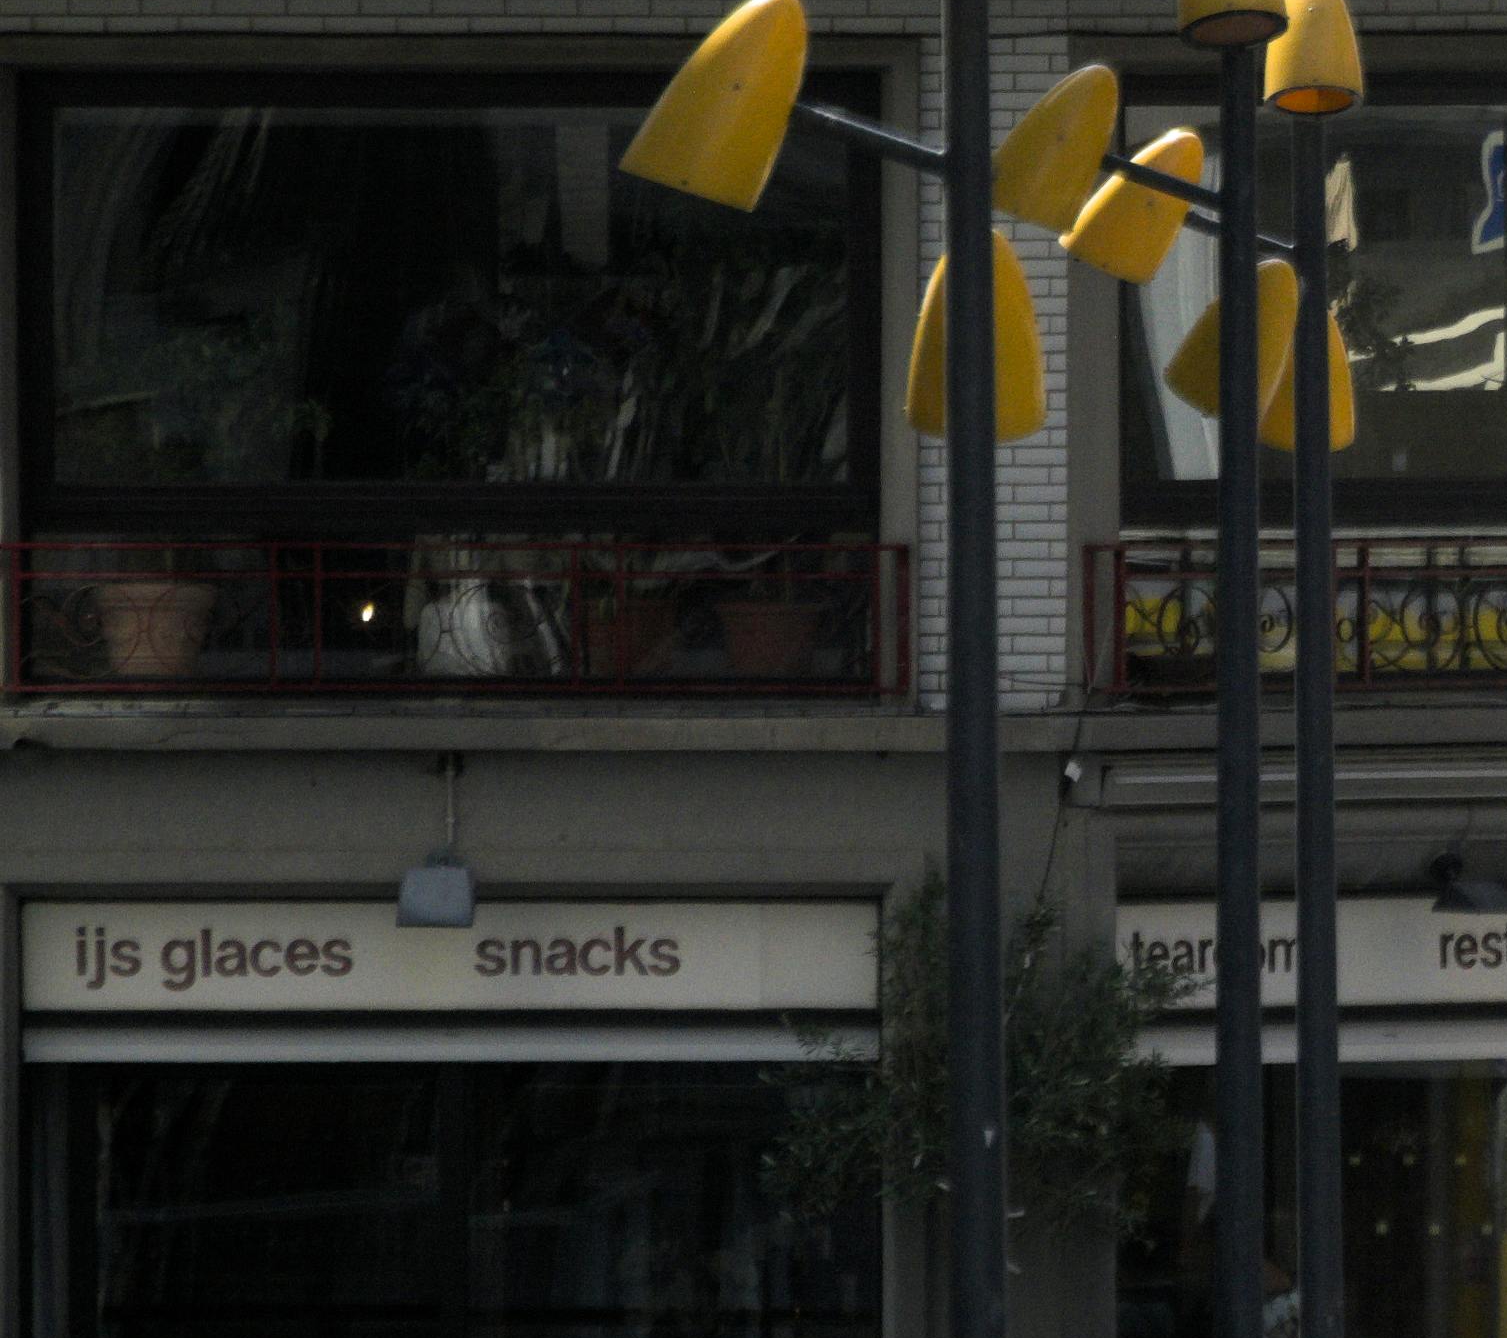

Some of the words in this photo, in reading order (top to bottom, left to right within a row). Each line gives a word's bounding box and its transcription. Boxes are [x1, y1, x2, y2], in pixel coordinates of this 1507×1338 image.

[74, 926, 142, 990] ijs
[160, 927, 353, 992] glaces
[474, 926, 682, 978] snacks
[1131, 930, 1297, 976] tearm
